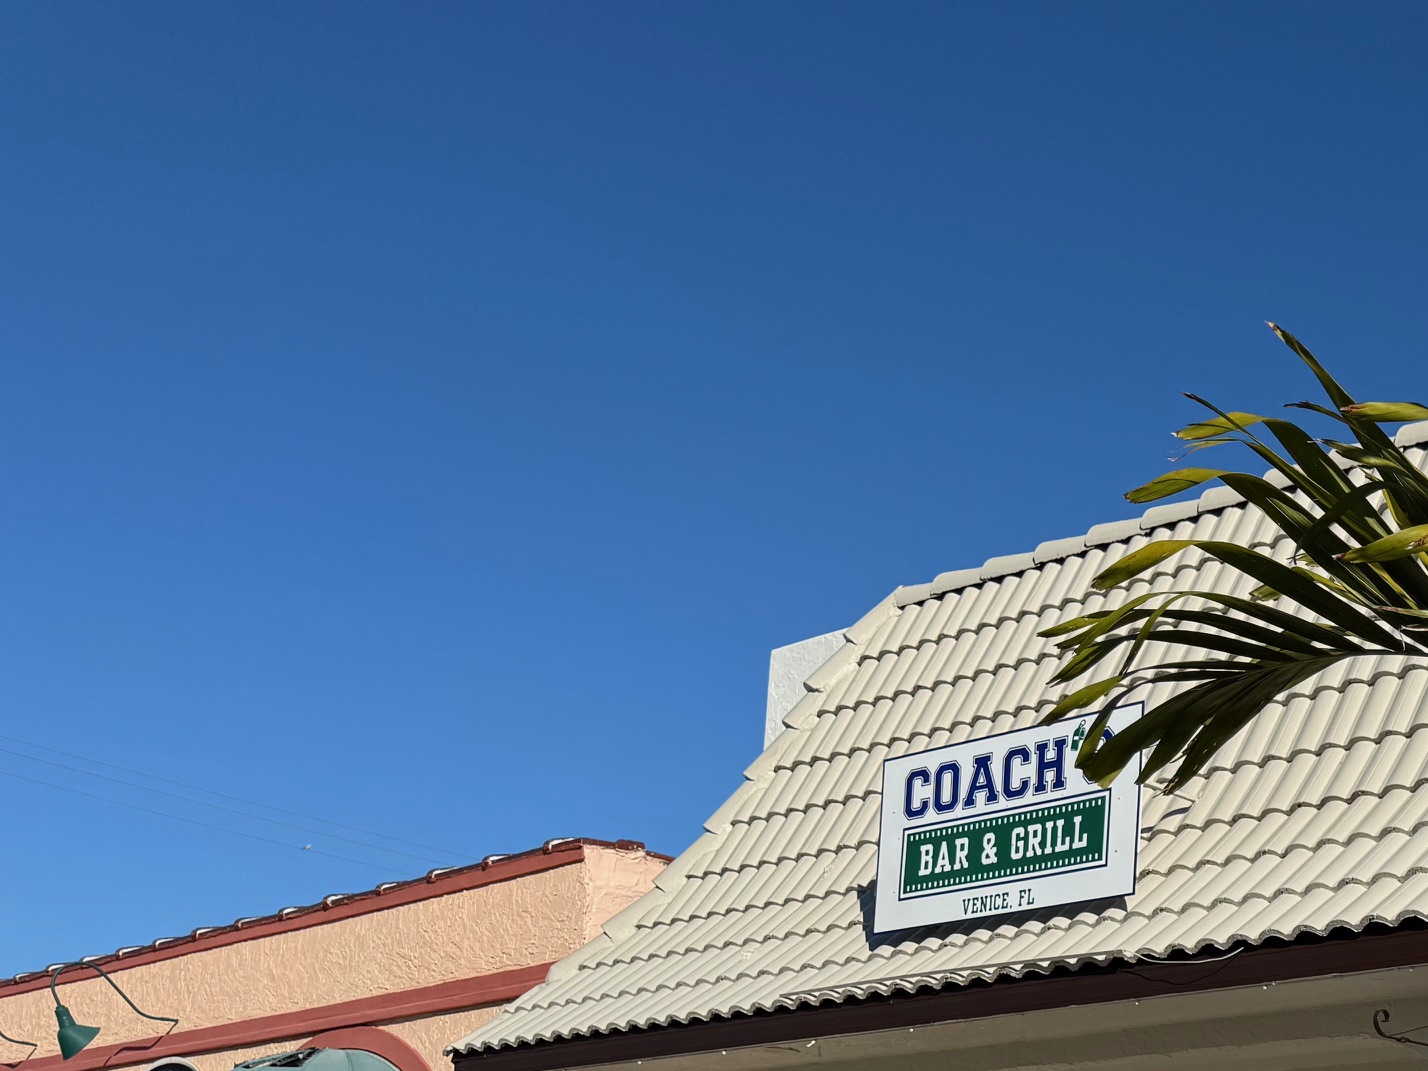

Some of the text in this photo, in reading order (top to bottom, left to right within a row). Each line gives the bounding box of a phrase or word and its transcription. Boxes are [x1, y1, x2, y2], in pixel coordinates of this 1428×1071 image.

[918, 815, 1088, 876] BAR & GRILL
[1018, 888, 1035, 907] FL
